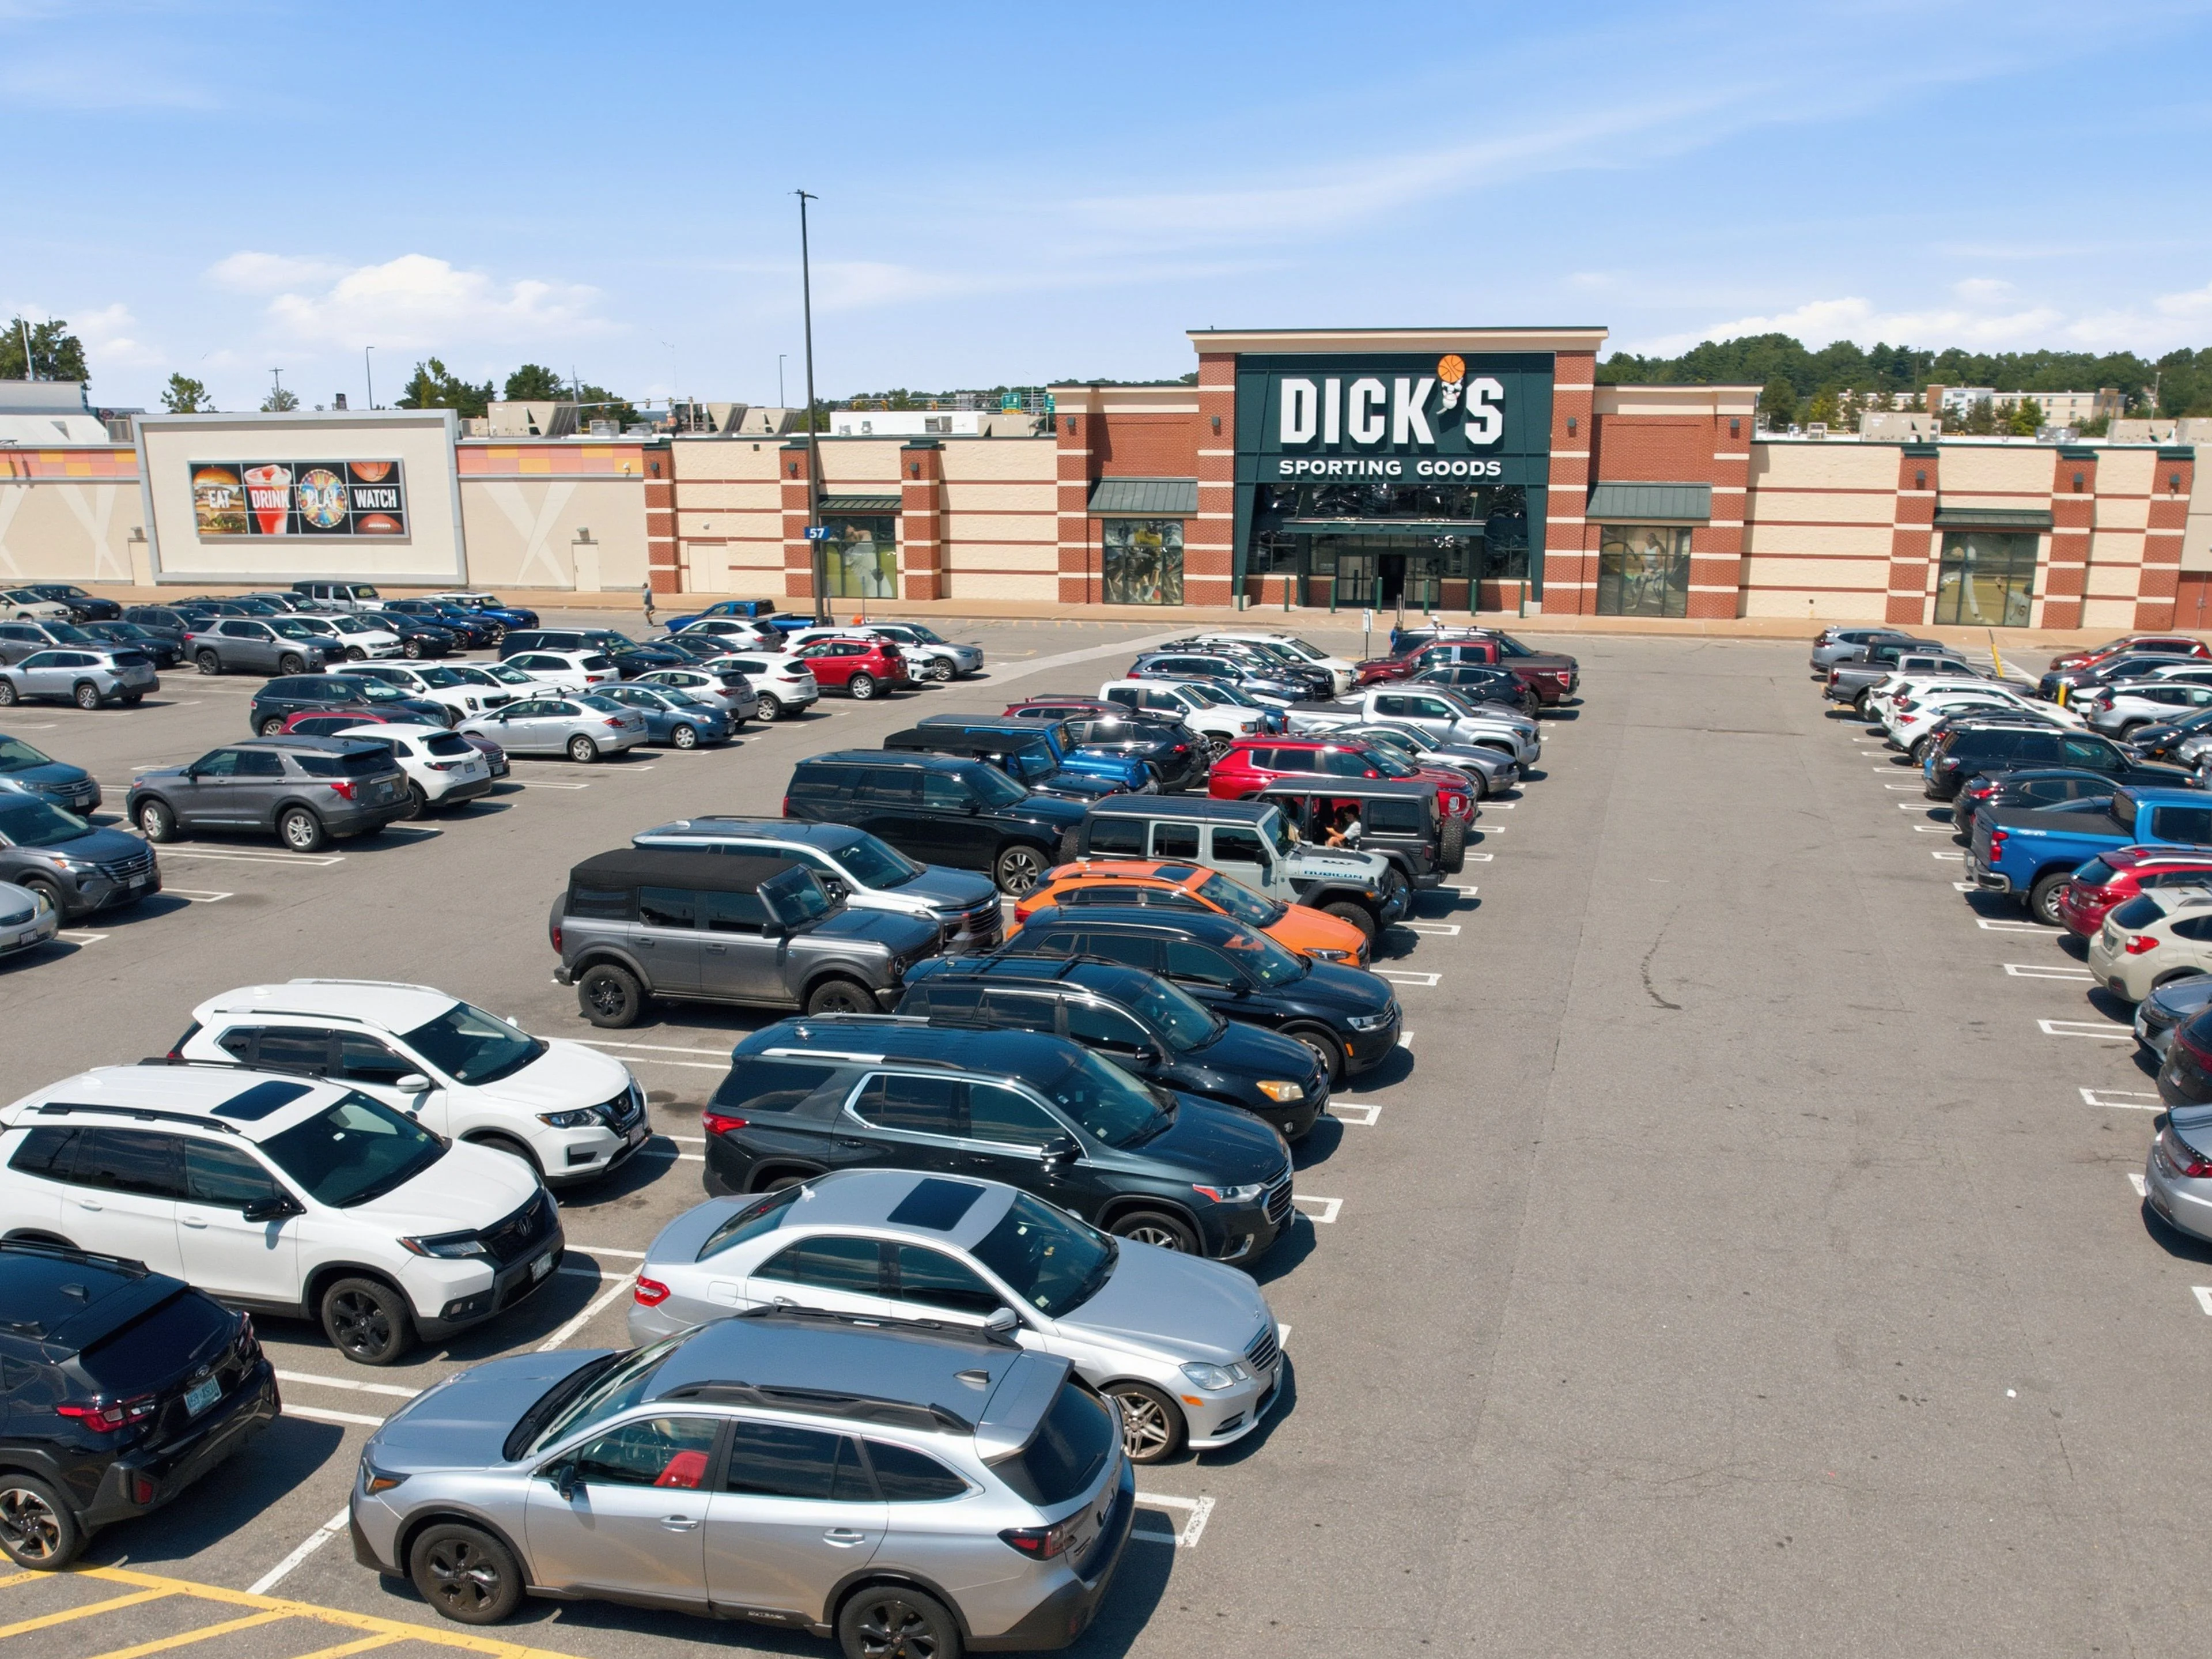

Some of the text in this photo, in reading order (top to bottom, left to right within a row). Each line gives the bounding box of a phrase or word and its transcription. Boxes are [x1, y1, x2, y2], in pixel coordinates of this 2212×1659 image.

[1280, 377, 1503, 444] DICK'S
[1279, 460, 1502, 477] SPORTING GOODS
[209, 489, 398, 508] EAT DRINK PLAY WATCH
[809, 527, 825, 538] 57
[1304, 870, 1362, 879] RUBICON
